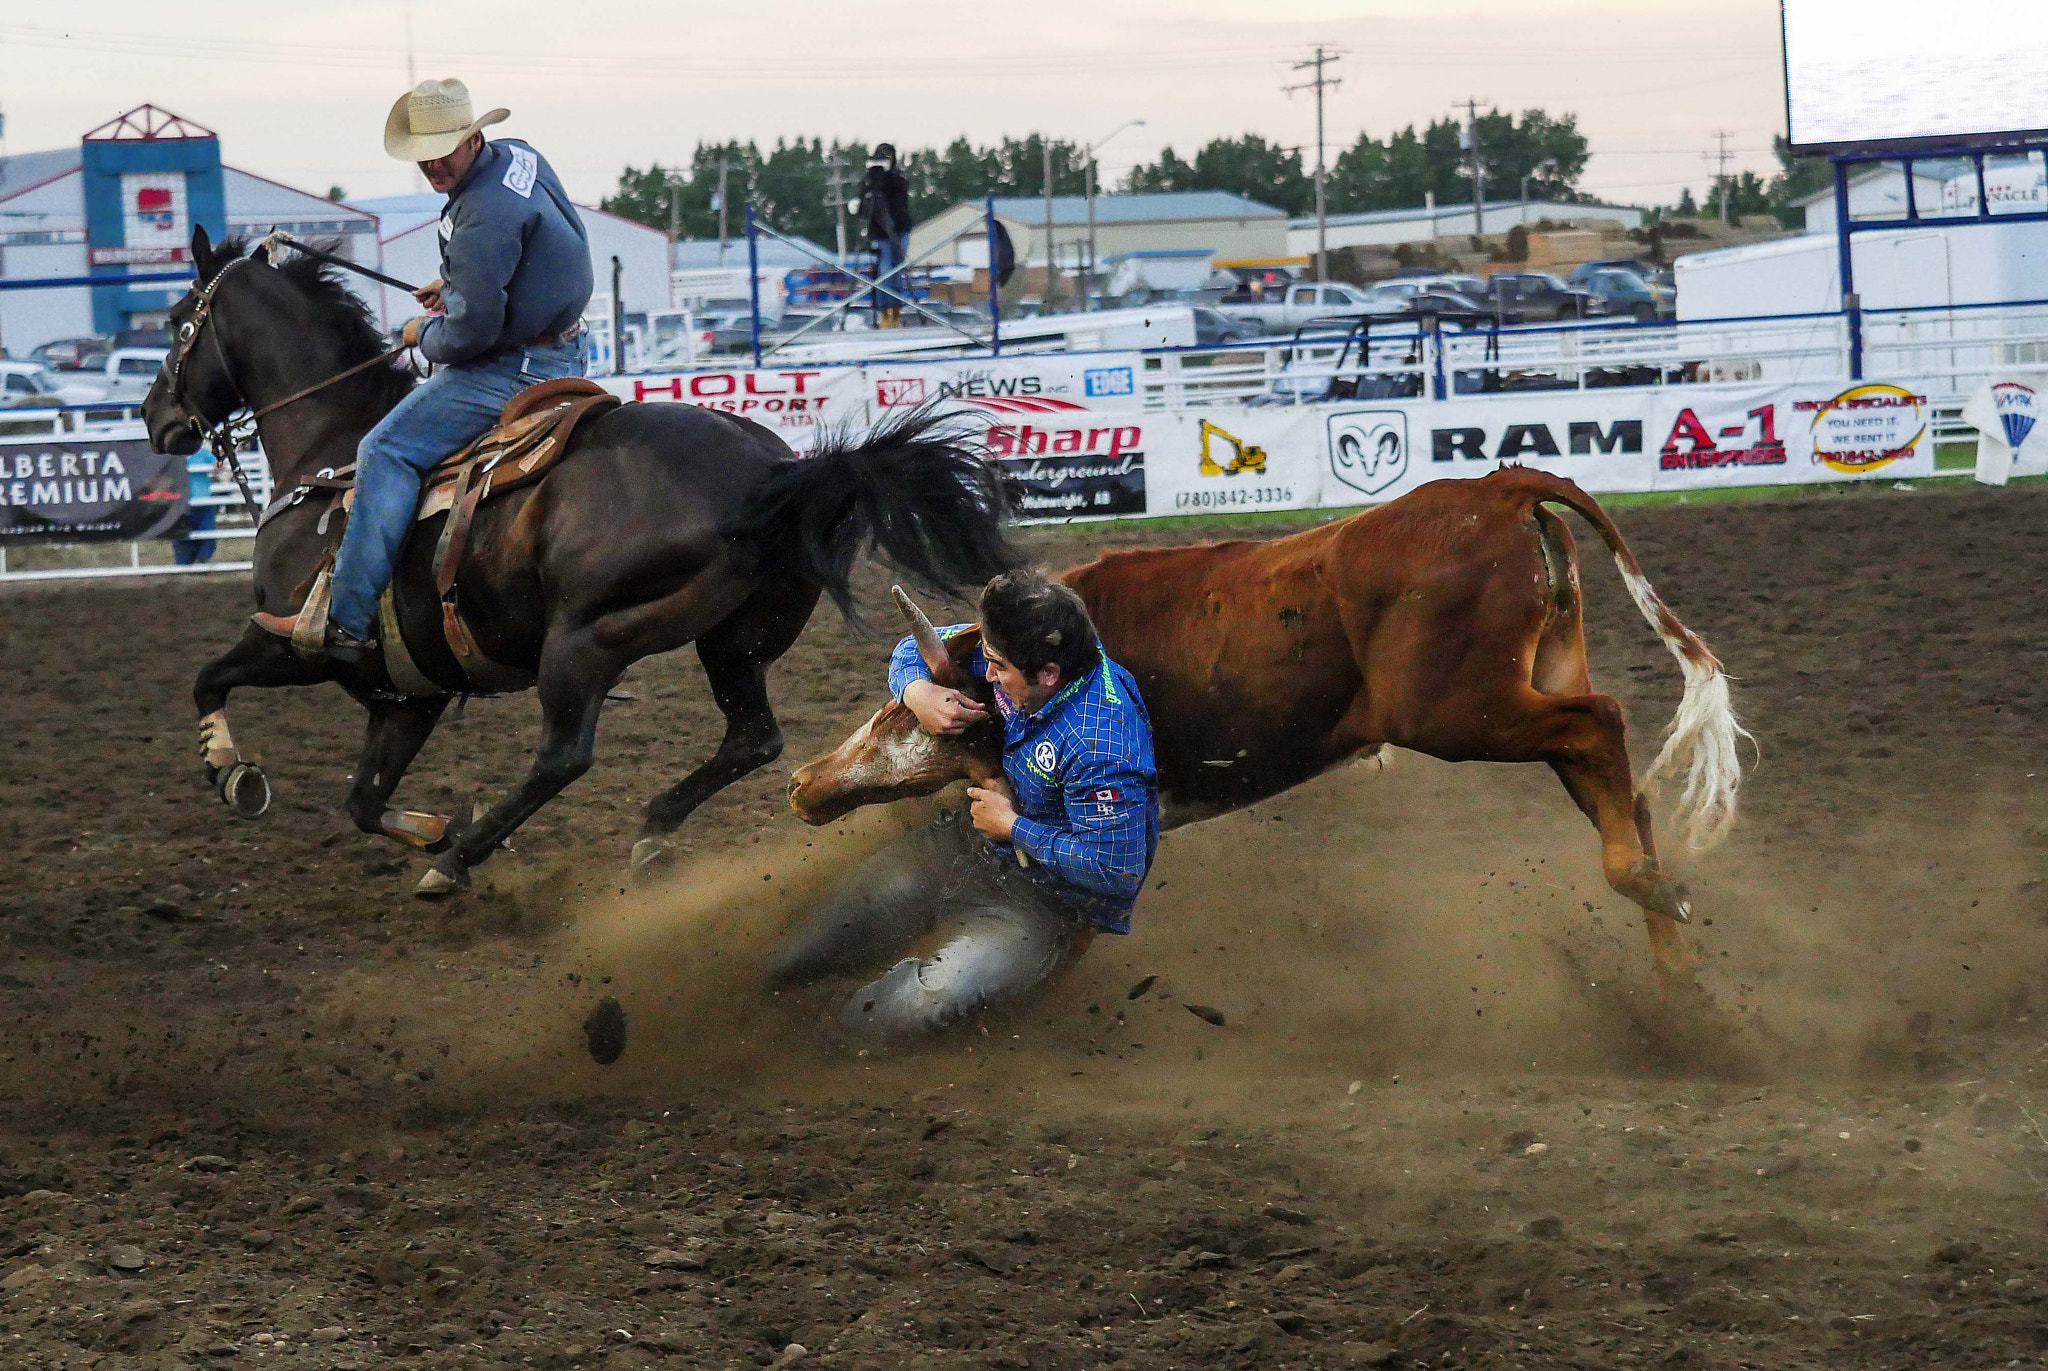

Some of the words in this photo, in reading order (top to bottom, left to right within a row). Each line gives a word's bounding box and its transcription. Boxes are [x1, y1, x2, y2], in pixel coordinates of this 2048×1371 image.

[634, 371, 821, 403] HOLT
[940, 376, 1041, 398] NEWS
[697, 397, 830, 415] NSPORT
[1660, 404, 1783, 453] A-1
[1827, 419, 1849, 428] YOU
[1853, 418, 1882, 426] NEED
[984, 425, 1142, 459] Sharp
[1431, 420, 1643, 461] RAM
[1832, 435, 1850, 444] WE
[1854, 434, 1881, 442] RENT
[0, 451, 125, 479] LBERTA
[0, 477, 132, 507] EMIUM
[1175, 487, 1292, 509] (780)842-3336
